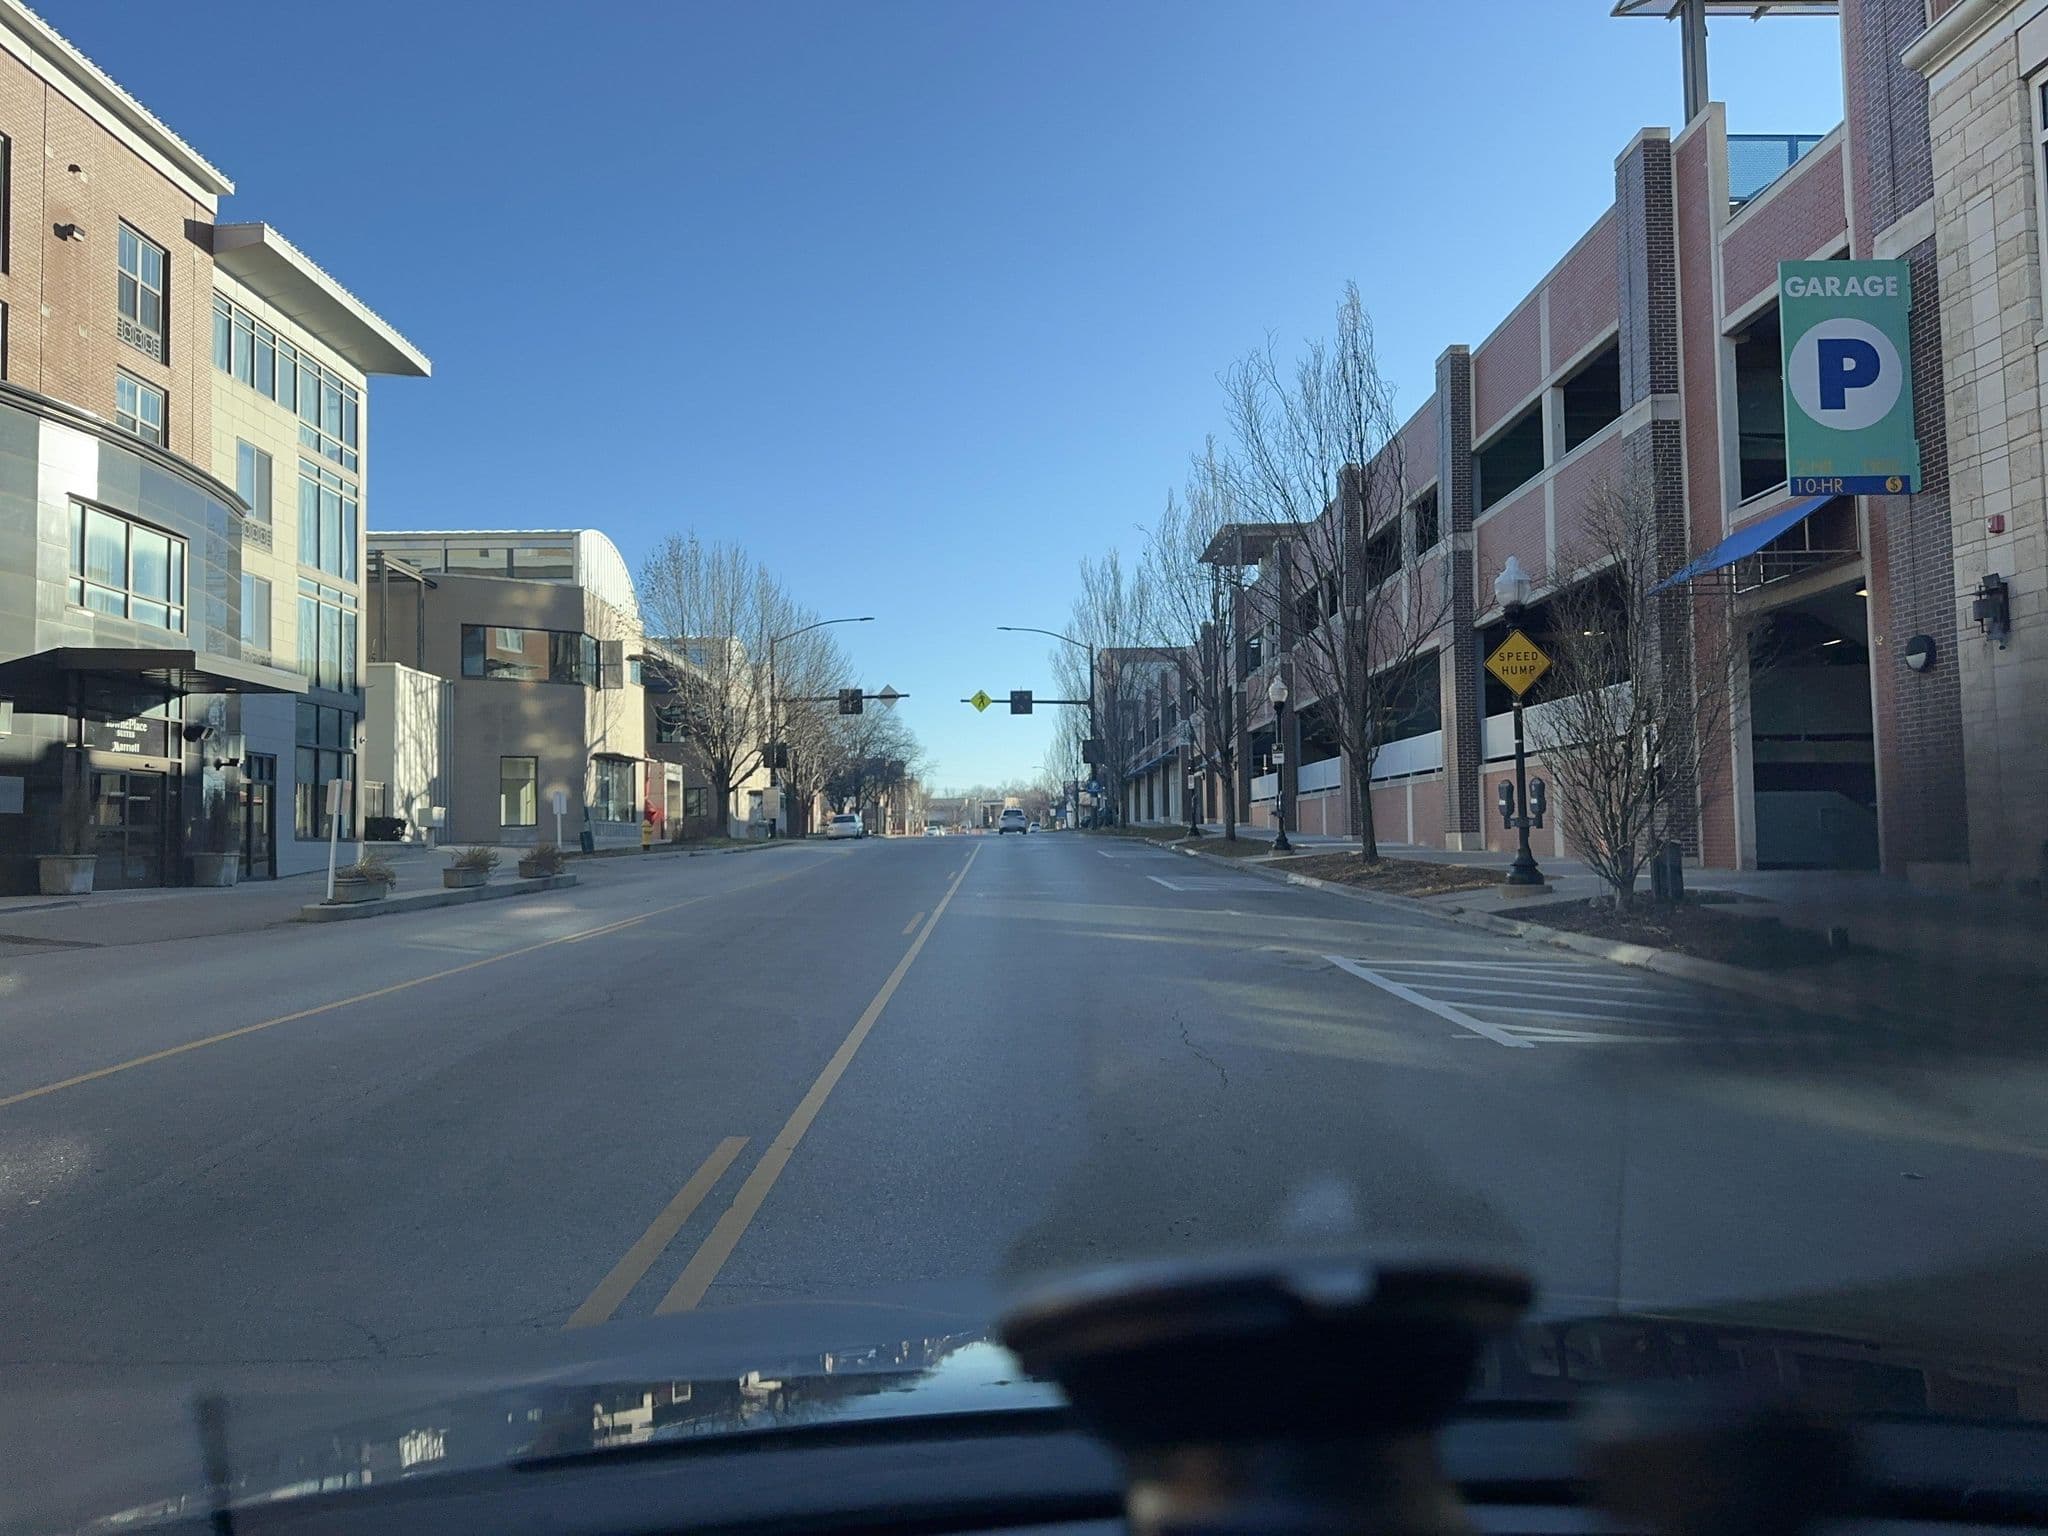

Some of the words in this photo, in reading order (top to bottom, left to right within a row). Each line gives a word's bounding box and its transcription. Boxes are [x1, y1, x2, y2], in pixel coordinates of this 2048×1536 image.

[1784, 276, 1898, 298] GARAGE
[1817, 338, 1881, 410] P
[1796, 478, 1844, 494] 10-HR
[1498, 651, 1538, 661] SPEED
[1501, 665, 1536, 675] HUMP
